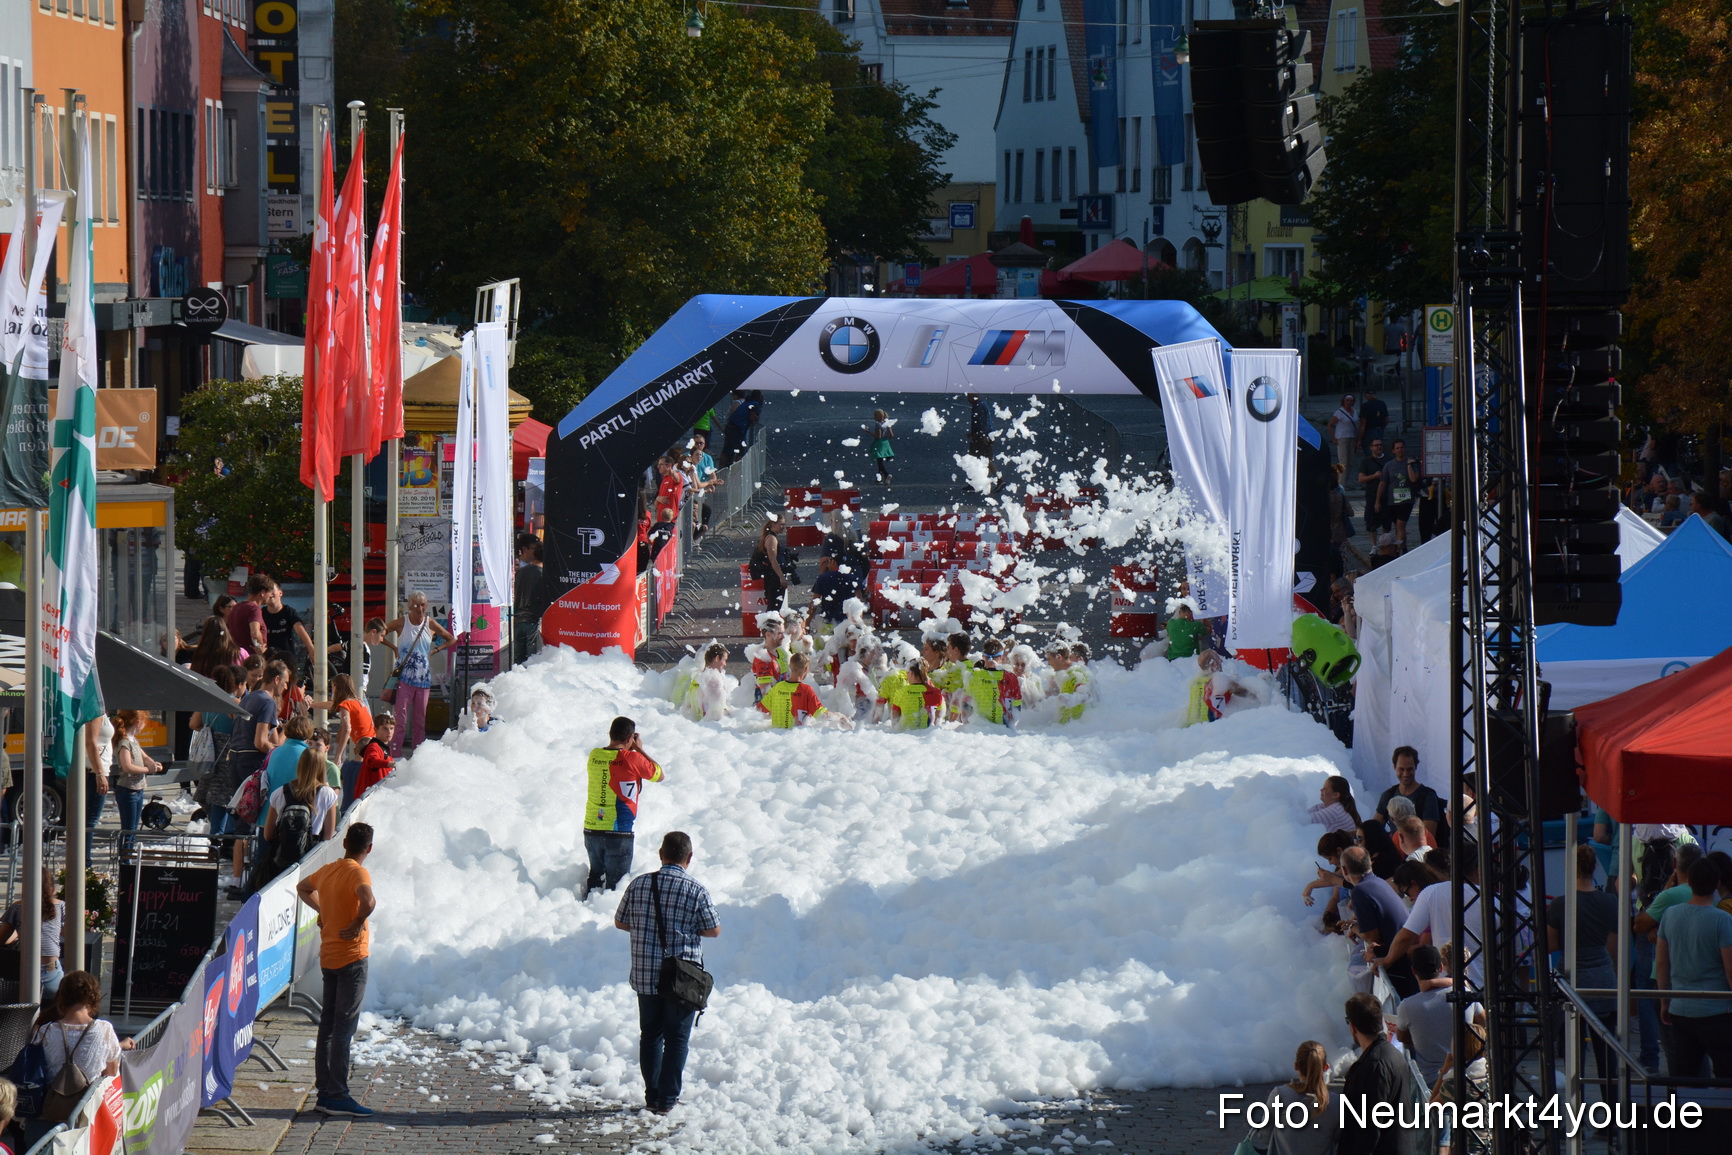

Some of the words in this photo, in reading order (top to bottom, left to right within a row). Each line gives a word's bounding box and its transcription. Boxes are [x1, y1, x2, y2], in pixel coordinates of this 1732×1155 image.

[277, 264, 300, 277] FASS
[579, 413, 632, 450] PARTL
[629, 359, 715, 420] NEUMARKT
[559, 600, 579, 609] BMW
[582, 602, 621, 612] Laufsport
[559, 630, 621, 639] www.bmw-partl.de
[1215, 697, 1224, 709] 7
[599, 769, 609, 807] Motorsport
[626, 782, 636, 798] 7
[170, 884, 205, 904] Hour
[140, 912, 179, 931] 17-21
